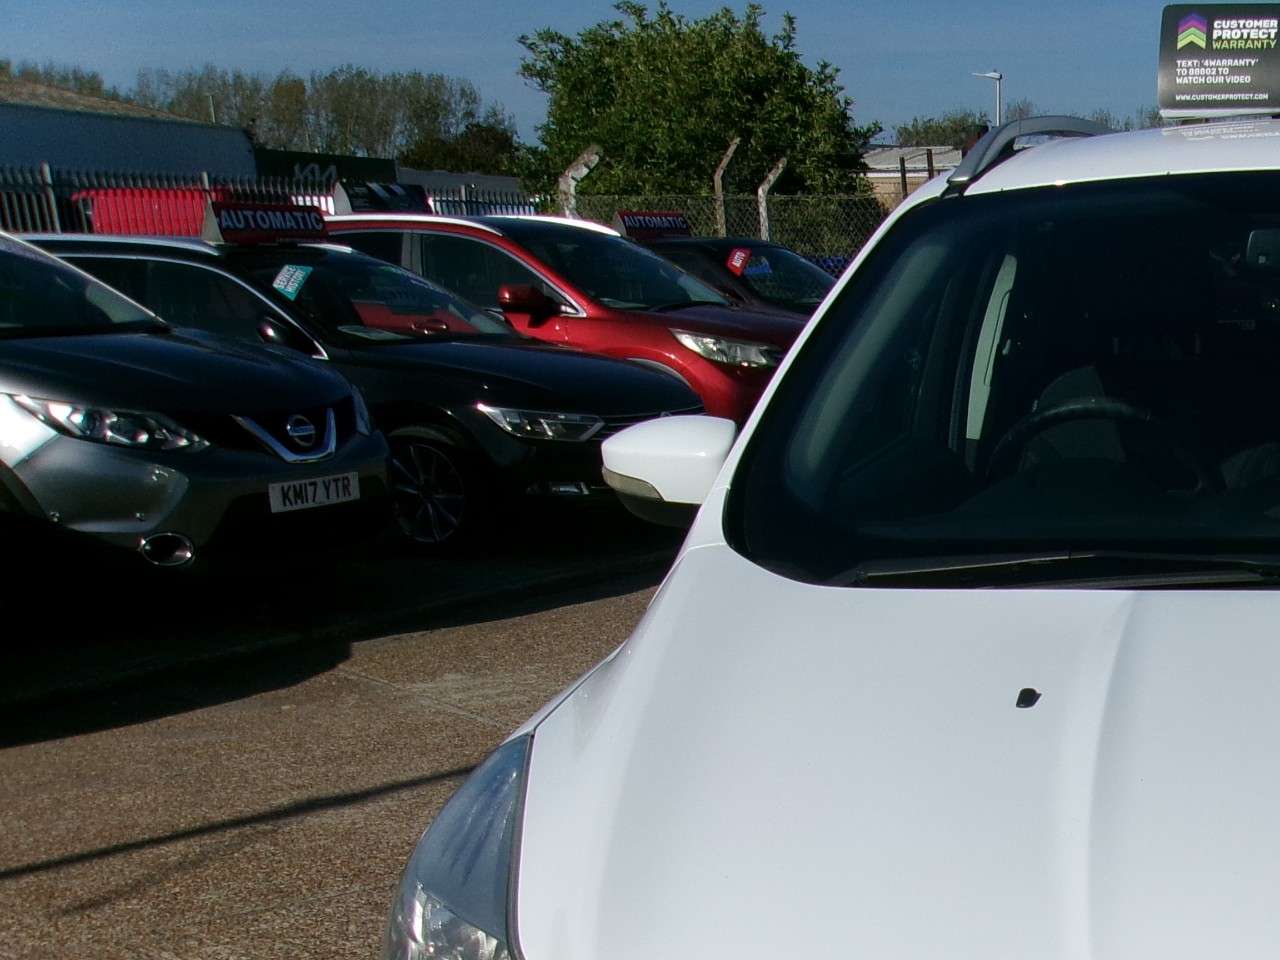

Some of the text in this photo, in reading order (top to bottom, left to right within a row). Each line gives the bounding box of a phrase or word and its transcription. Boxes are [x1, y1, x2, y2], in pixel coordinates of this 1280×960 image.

[1213, 19, 1279, 29] CUSTOMER
[1212, 29, 1278, 40] PROTECT
[1212, 40, 1278, 50] WARRANTY
[1176, 68, 1188, 76] TO
[1219, 67, 1230, 75] TO
[1176, 75, 1251, 84] WATCH OUR VIDEO
[220, 208, 324, 231] AUTOMATIC
[624, 215, 687, 230] AUTOMATIC
[281, 475, 353, 507] KM17 YTR
